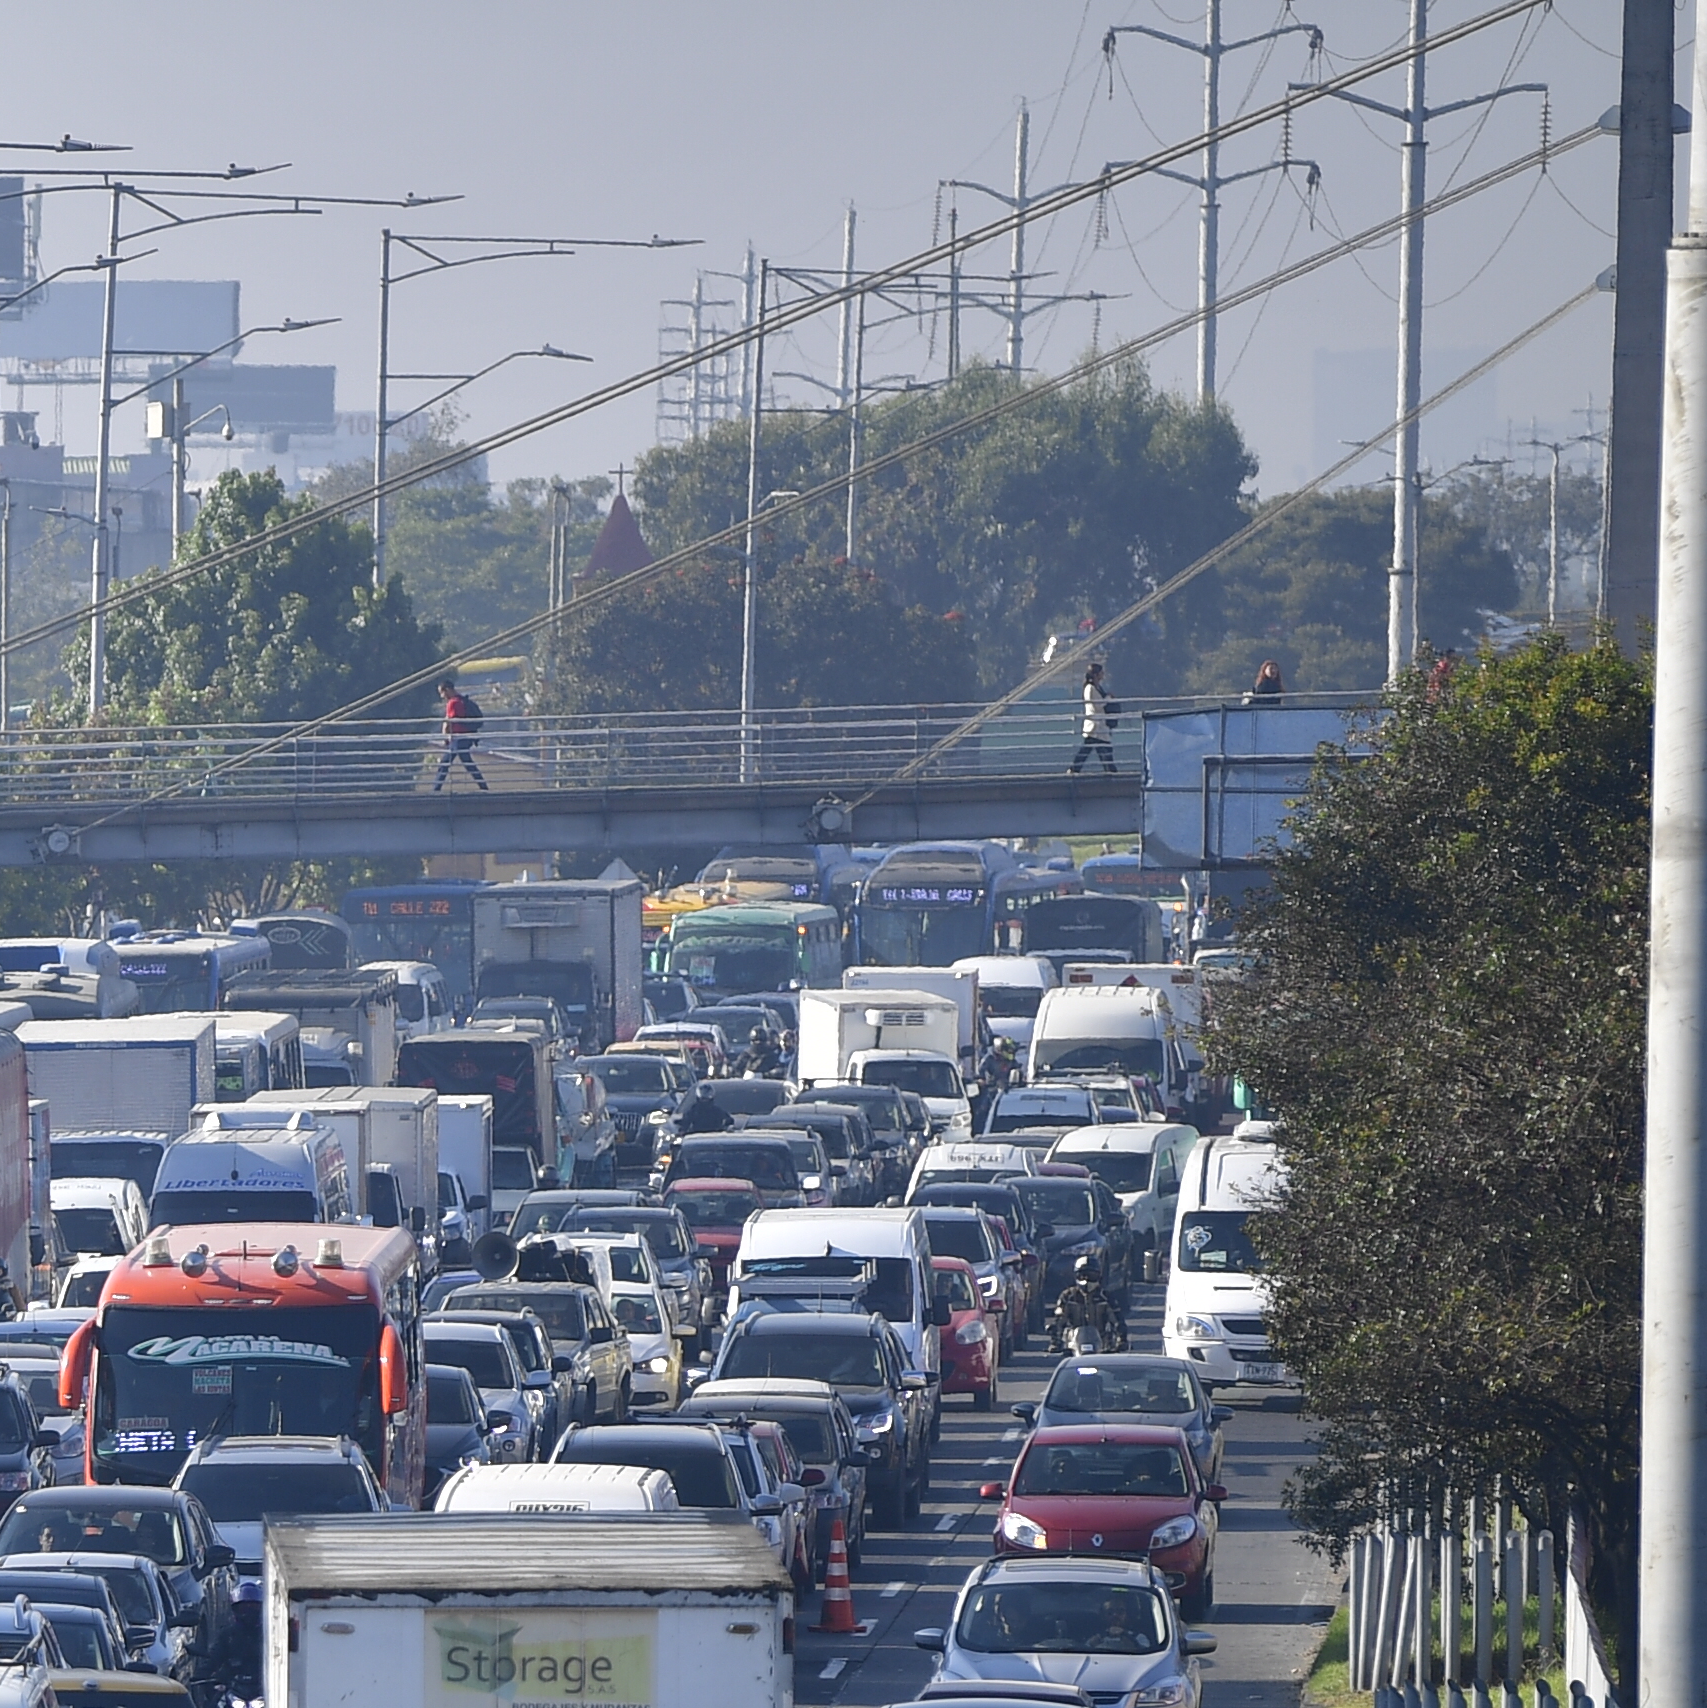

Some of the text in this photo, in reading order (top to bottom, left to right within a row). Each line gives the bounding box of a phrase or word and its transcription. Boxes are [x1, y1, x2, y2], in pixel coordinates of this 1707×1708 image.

[164, 1178, 304, 1190] Libertadores
[127, 1335, 335, 1365] MACARENA
[446, 1646, 613, 1694] Storage
